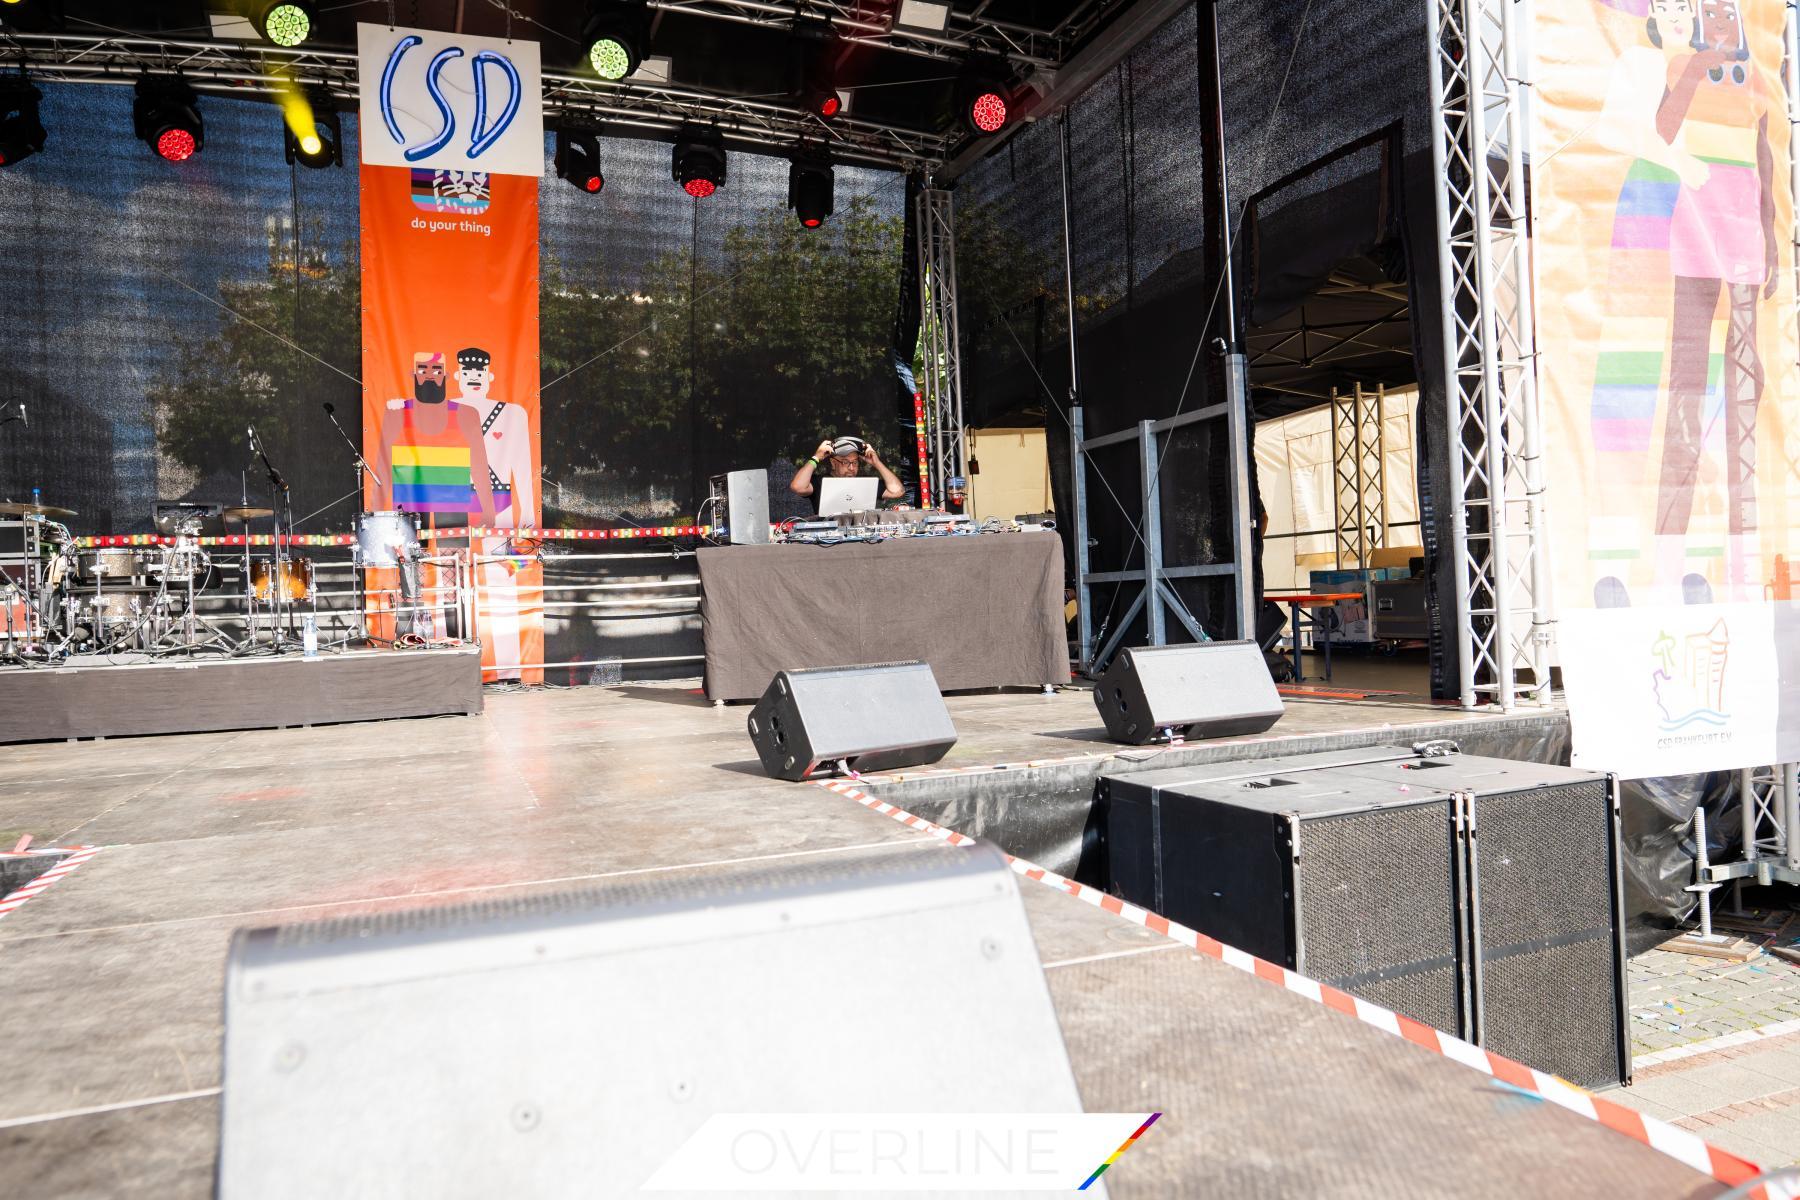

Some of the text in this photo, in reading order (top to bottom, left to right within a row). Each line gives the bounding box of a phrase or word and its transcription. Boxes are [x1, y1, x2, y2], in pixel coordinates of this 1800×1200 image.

[379, 35, 522, 162] CSD
[411, 216, 491, 237] do your thing
